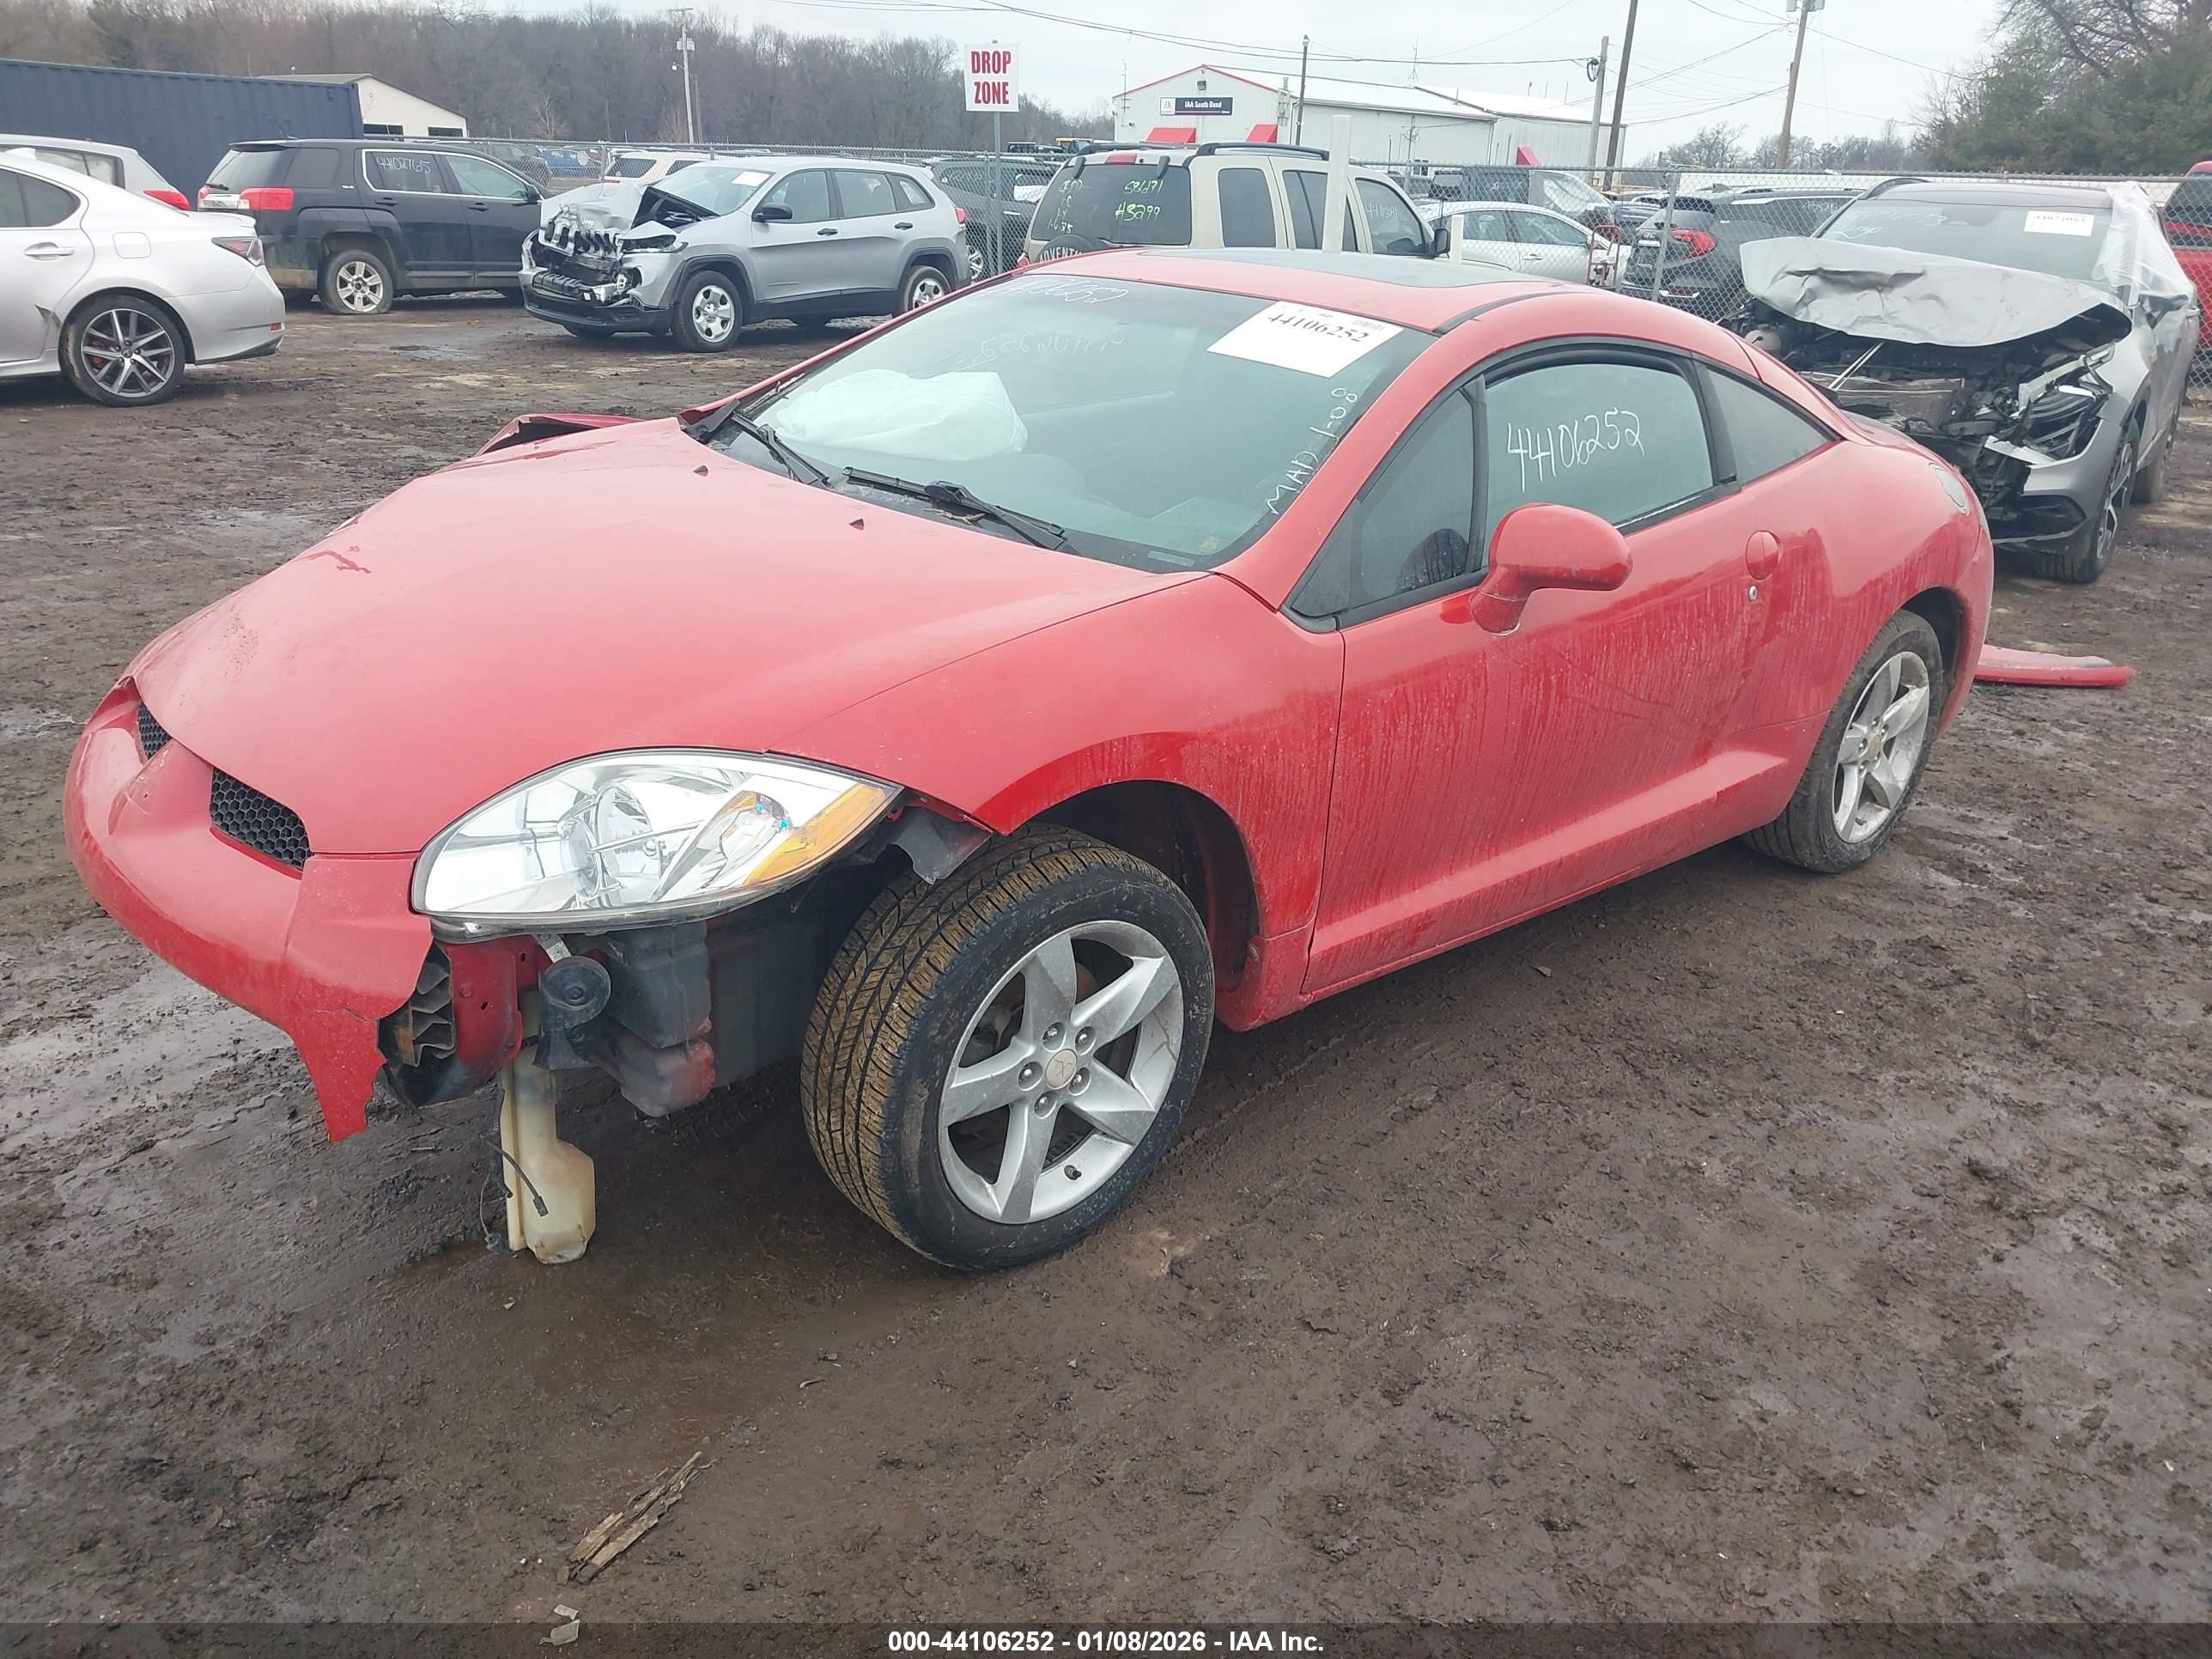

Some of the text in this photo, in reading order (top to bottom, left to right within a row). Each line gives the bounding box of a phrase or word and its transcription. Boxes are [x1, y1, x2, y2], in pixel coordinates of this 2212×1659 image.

[971, 51, 1012, 74] DROP
[974, 82, 1010, 104] ZONE
[1267, 313, 1370, 343] 44106252
[1507, 407, 1645, 494] 44106252
